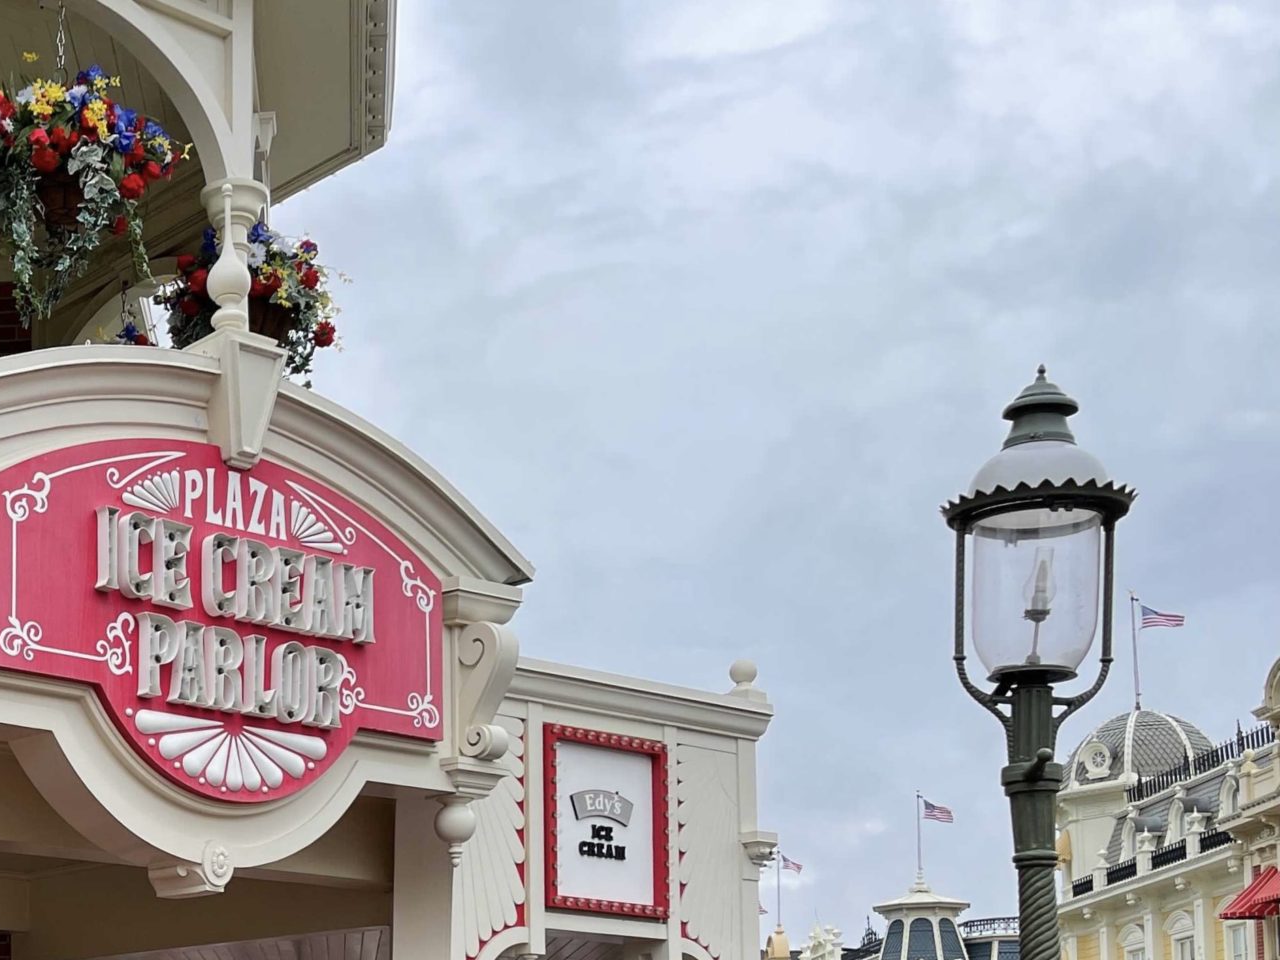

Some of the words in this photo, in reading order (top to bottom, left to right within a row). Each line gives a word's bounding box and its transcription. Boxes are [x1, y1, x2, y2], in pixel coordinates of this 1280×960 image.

[184, 467, 288, 541] PLAZA
[94, 505, 194, 611] ICE
[201, 532, 376, 645] CREAM
[136, 611, 345, 730] PARLOR
[584, 793, 622, 816] Edy's
[578, 840, 627, 861] CREAM
[590, 823, 614, 842] ICE
